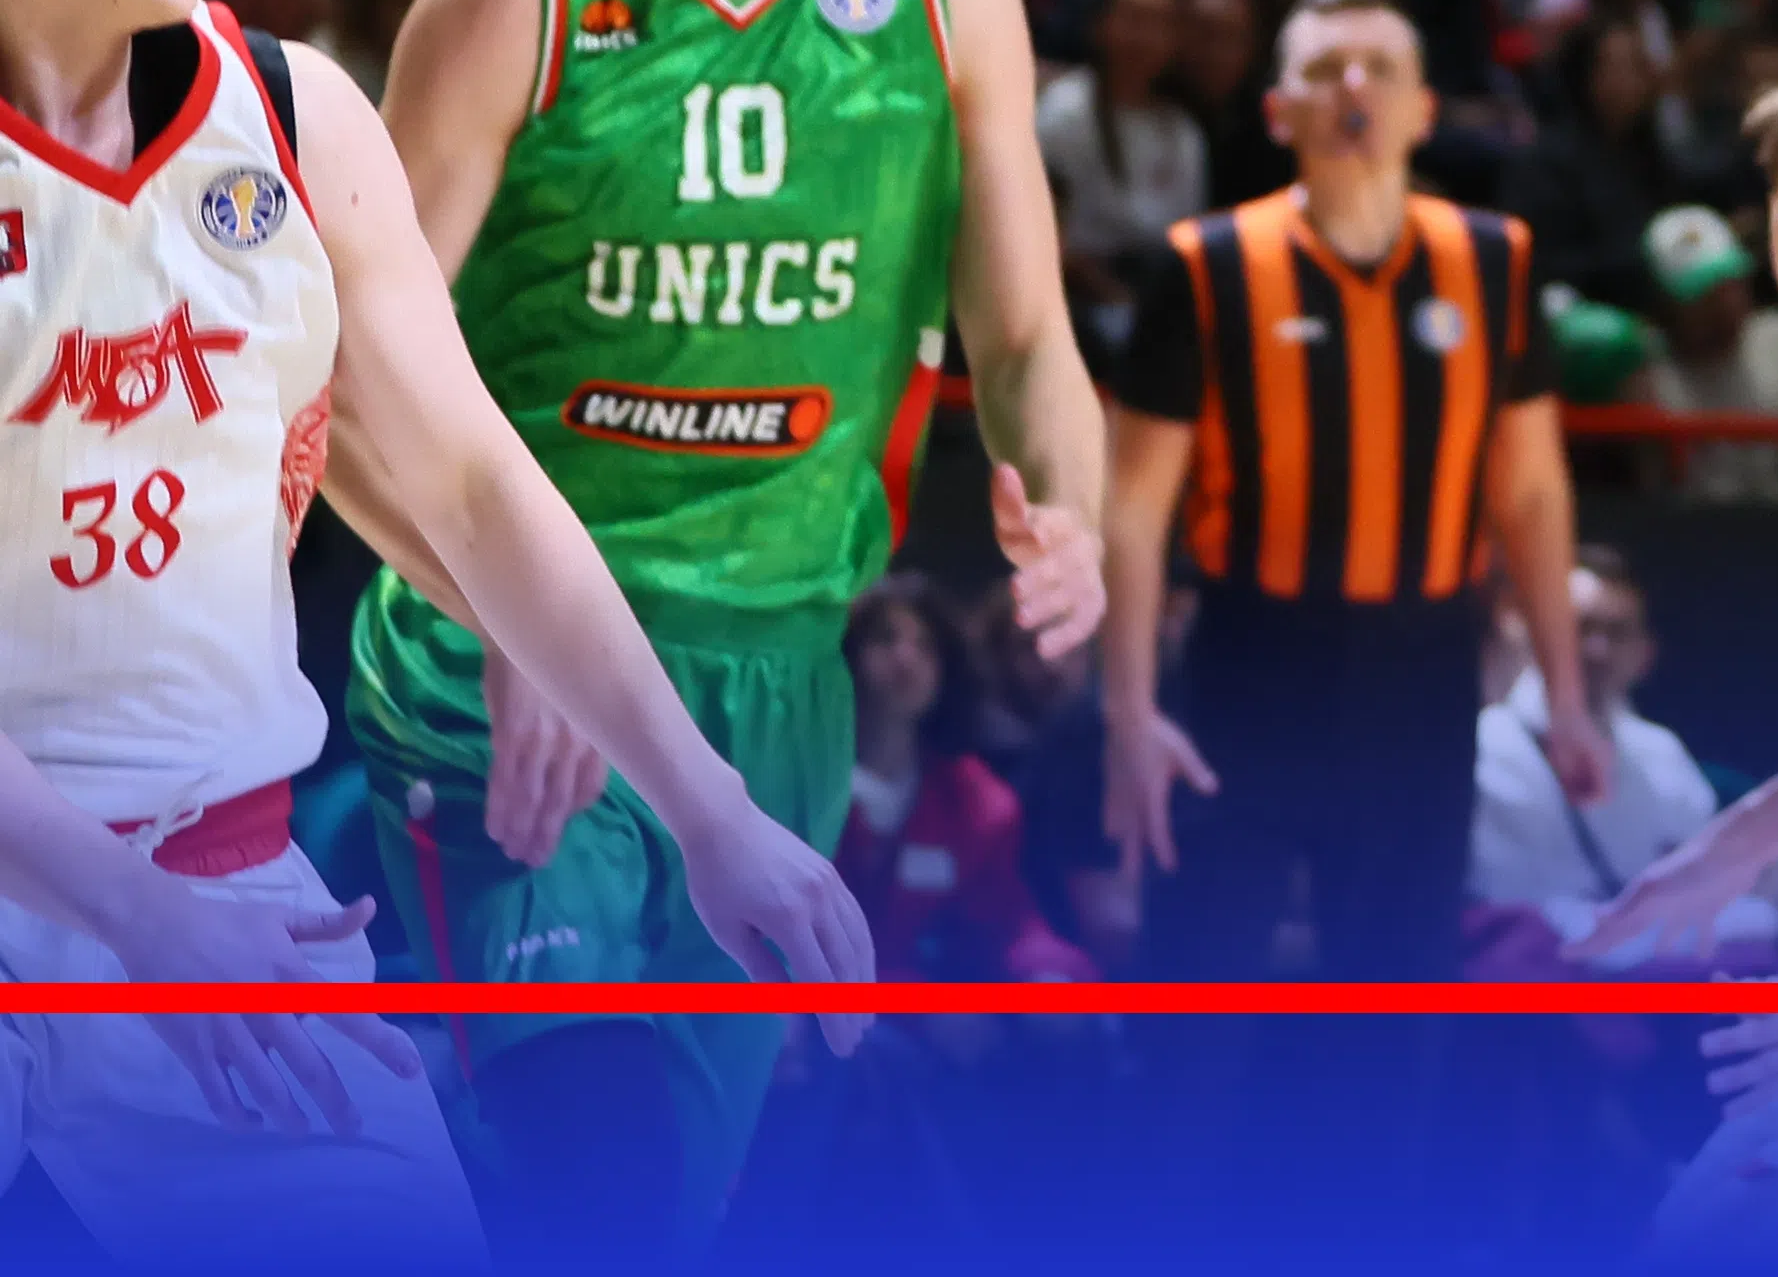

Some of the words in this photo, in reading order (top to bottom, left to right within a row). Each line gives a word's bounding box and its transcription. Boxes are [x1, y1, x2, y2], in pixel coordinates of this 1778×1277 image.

[678, 83, 785, 202] 10
[586, 237, 858, 325] UNICS
[583, 393, 786, 444] WINLINE
[50, 467, 186, 589] 38
